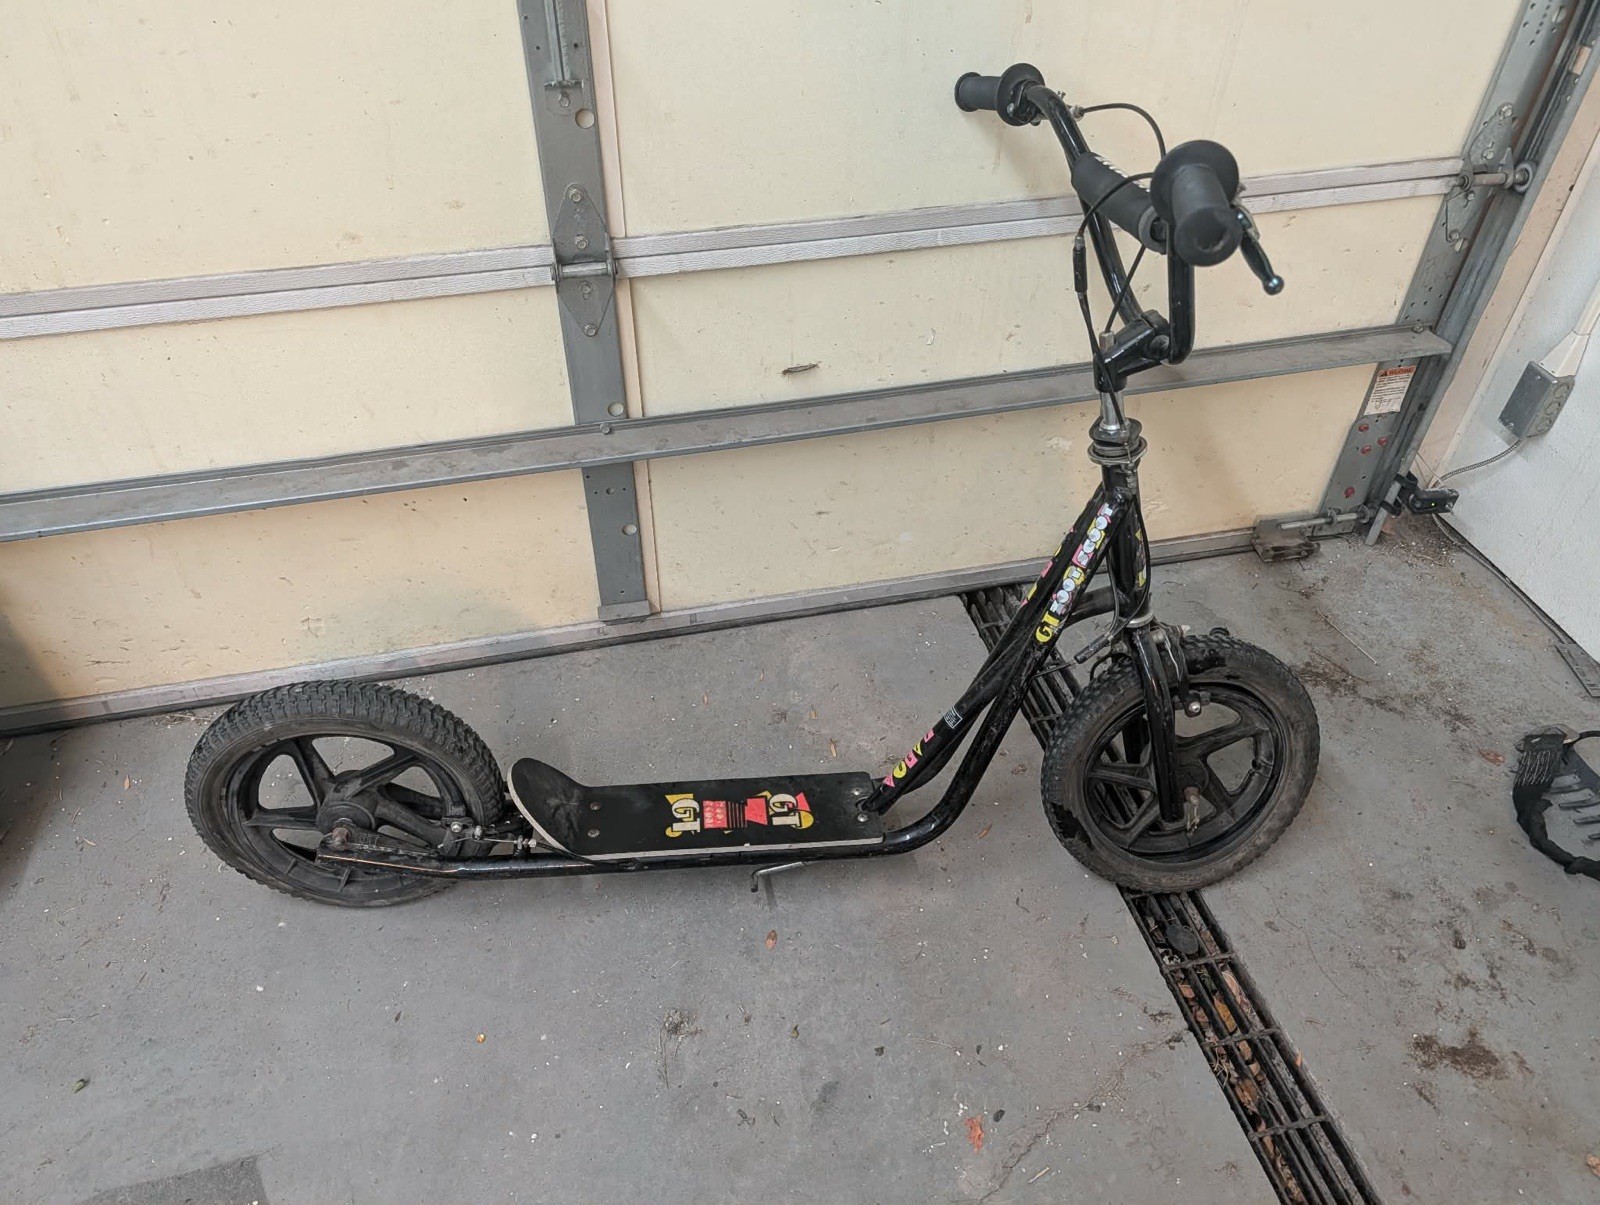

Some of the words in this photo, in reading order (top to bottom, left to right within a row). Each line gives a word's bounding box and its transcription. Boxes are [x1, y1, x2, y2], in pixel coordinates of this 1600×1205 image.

[1035, 611, 1060, 643] GT
[1077, 502, 1114, 567] SCOOT
[671, 797, 701, 834] GT
[769, 792, 801, 828] GT
